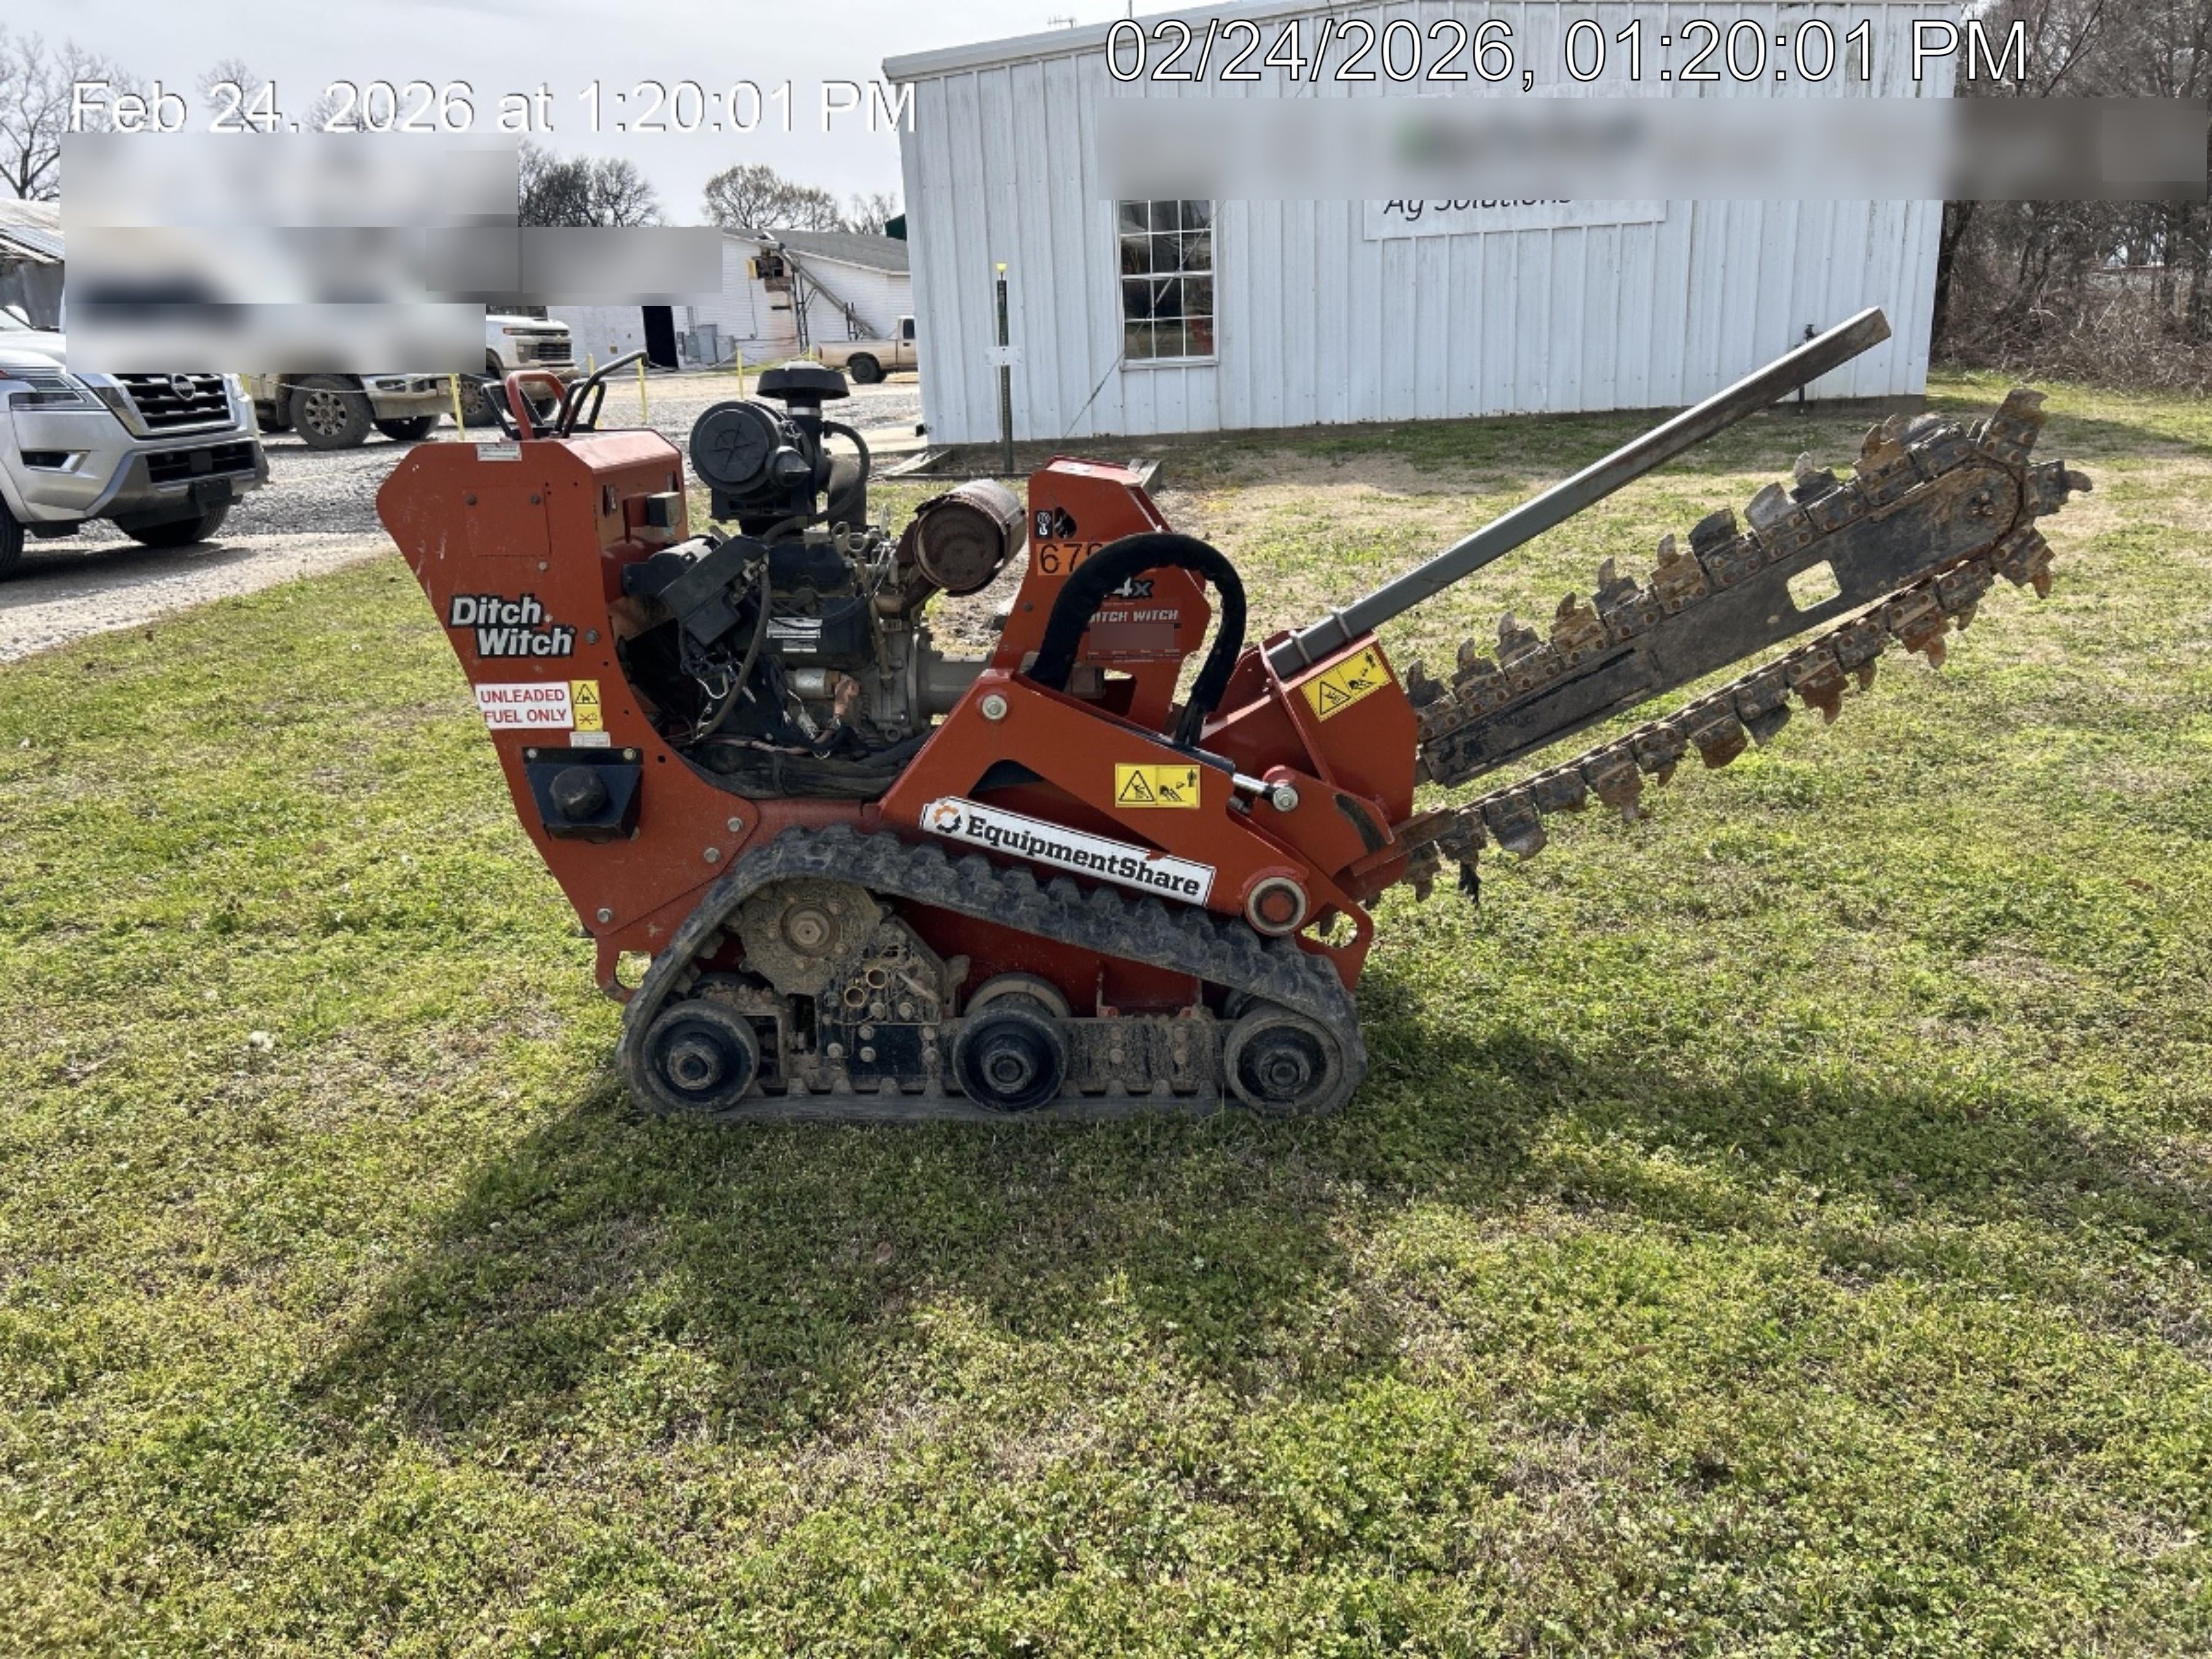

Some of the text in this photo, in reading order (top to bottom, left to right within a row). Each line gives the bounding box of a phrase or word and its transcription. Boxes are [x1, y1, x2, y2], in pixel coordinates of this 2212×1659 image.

[450, 595, 543, 627] Ditch
[1133, 609, 1179, 622] WITCH
[477, 627, 574, 656] Witch
[480, 688, 565, 703] UNLEADED
[483, 708, 567, 723] FUEL ONLY
[965, 814, 1202, 897] EquipmentShare
